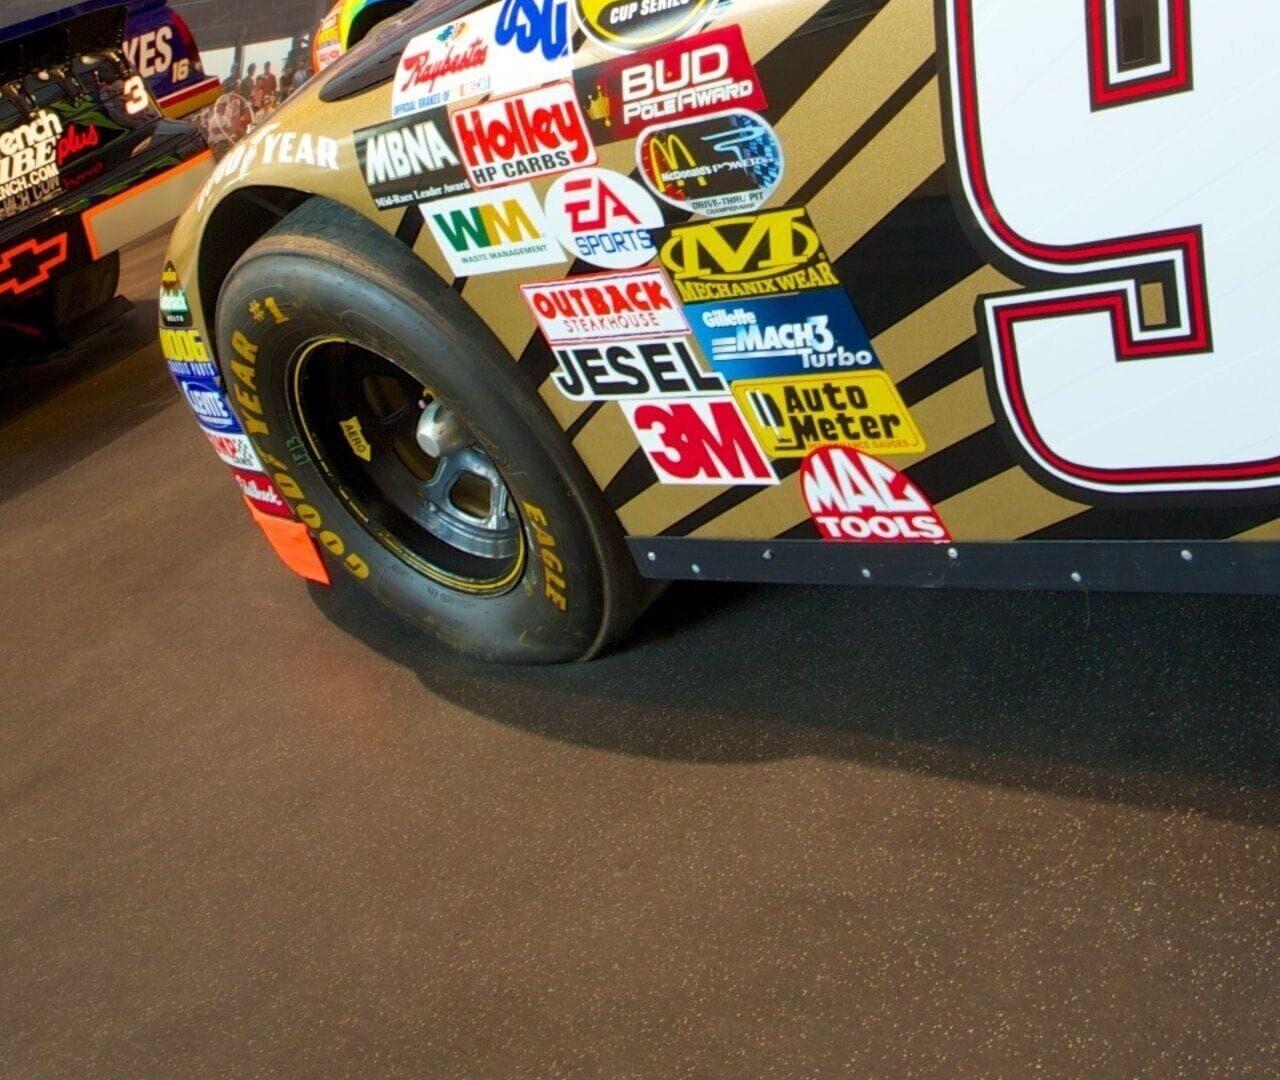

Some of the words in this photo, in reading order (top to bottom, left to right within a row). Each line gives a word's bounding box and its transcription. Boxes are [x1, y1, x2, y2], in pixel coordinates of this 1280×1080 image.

[609, 1, 639, 25] CUP
[401, 36, 489, 94] Raybestos
[621, 43, 730, 100] BUD
[124, 74, 149, 115] 3
[56, 122, 100, 166] plus
[455, 98, 589, 167] Holley
[366, 120, 460, 185] MBNA
[472, 166, 498, 185] HP
[501, 150, 570, 178] CARBS
[661, 165, 713, 183] McDonald's
[374, 190, 415, 209] Mid-Race
[414, 185, 443, 201] Leader
[443, 178, 471, 194] Award
[564, 177, 643, 234] EA
[691, 194, 747, 210] DRIVE-THRU
[748, 191, 765, 202] PIT
[433, 198, 544, 253] WM
[575, 228, 656, 257] SPORTS
[460, 252, 489, 265] WASTE
[489, 243, 549, 261] MANAGEMENT
[532, 280, 673, 321] OUTBACK
[674, 278, 775, 304] MECHANIX
[777, 260, 840, 291] WEAR
[248, 296, 291, 325] #1
[562, 311, 660, 334] STEAKHOUSE
[702, 307, 758, 329] Gillette
[552, 341, 725, 398] JESEL
[796, 345, 873, 369] Turbo
[783, 381, 869, 414] Auto
[344, 423, 367, 454] AERO
[633, 403, 773, 480] 3M
[789, 412, 902, 449] Meter
[803, 448, 933, 513] MAC
[815, 516, 946, 539] TOOLS
[522, 500, 568, 611] EAGLE
